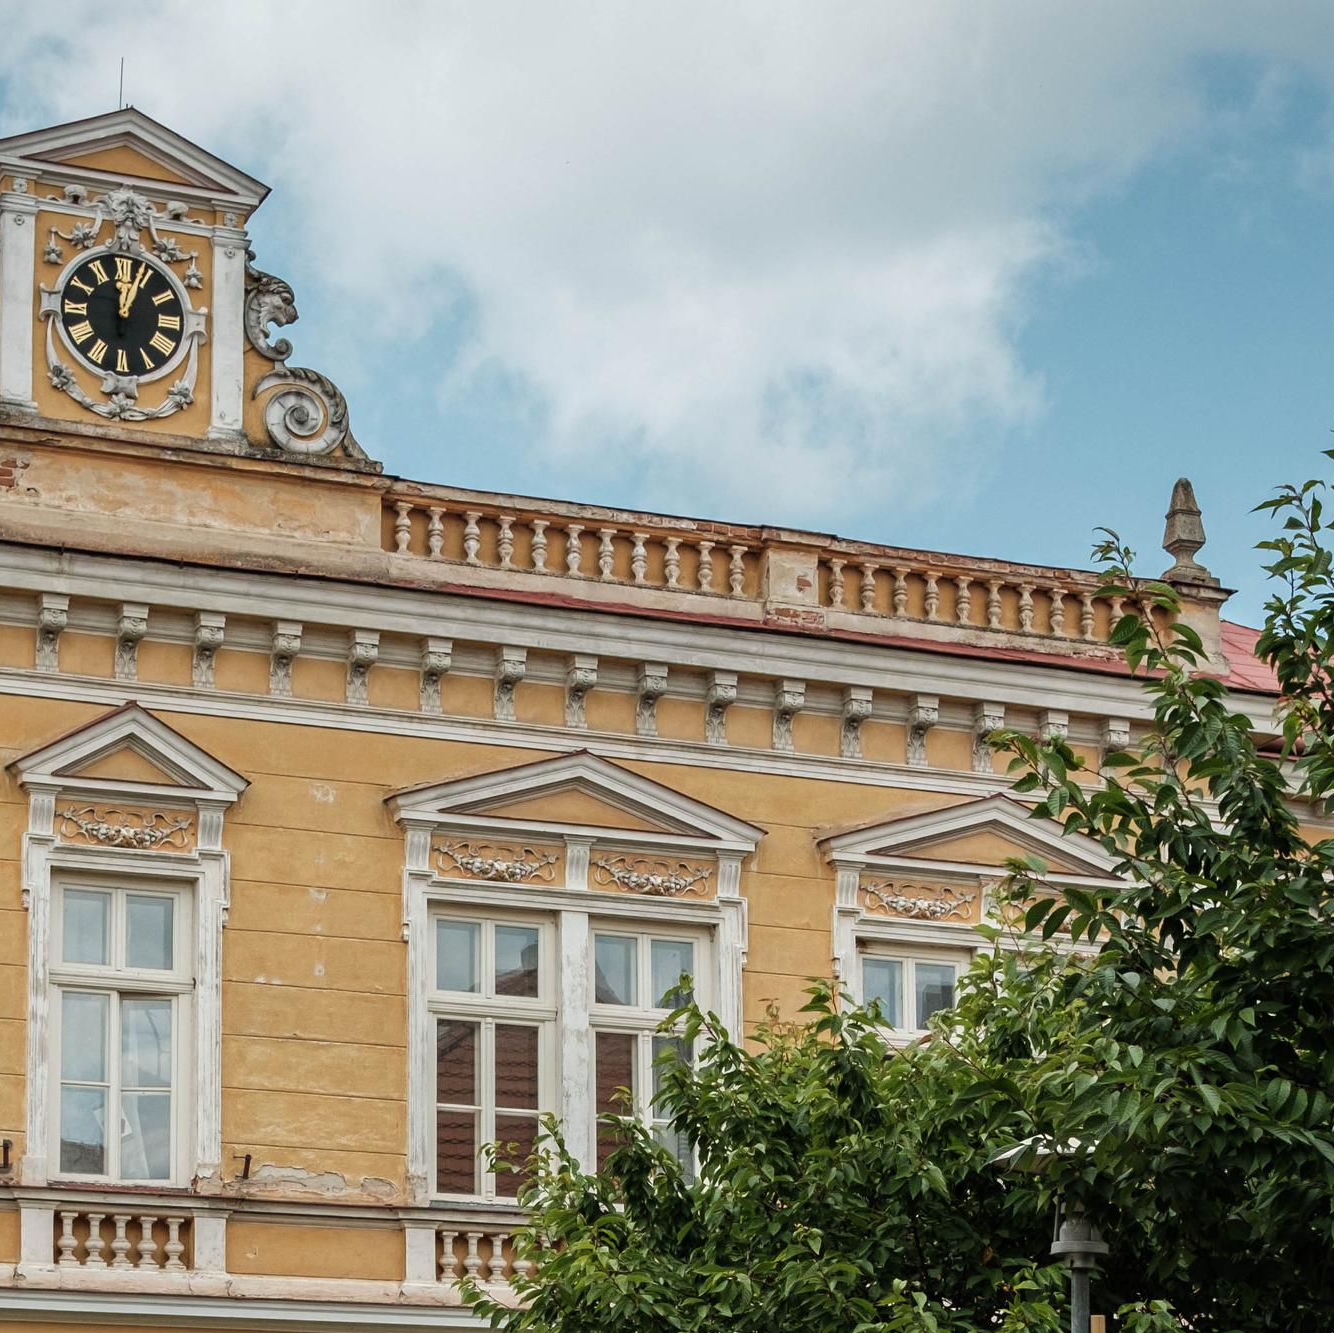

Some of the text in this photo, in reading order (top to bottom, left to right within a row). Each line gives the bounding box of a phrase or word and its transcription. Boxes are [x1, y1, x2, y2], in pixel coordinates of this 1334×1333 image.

[70, 275, 95, 295] X
[158, 313, 180, 331] III
[139, 347, 155, 369] V
